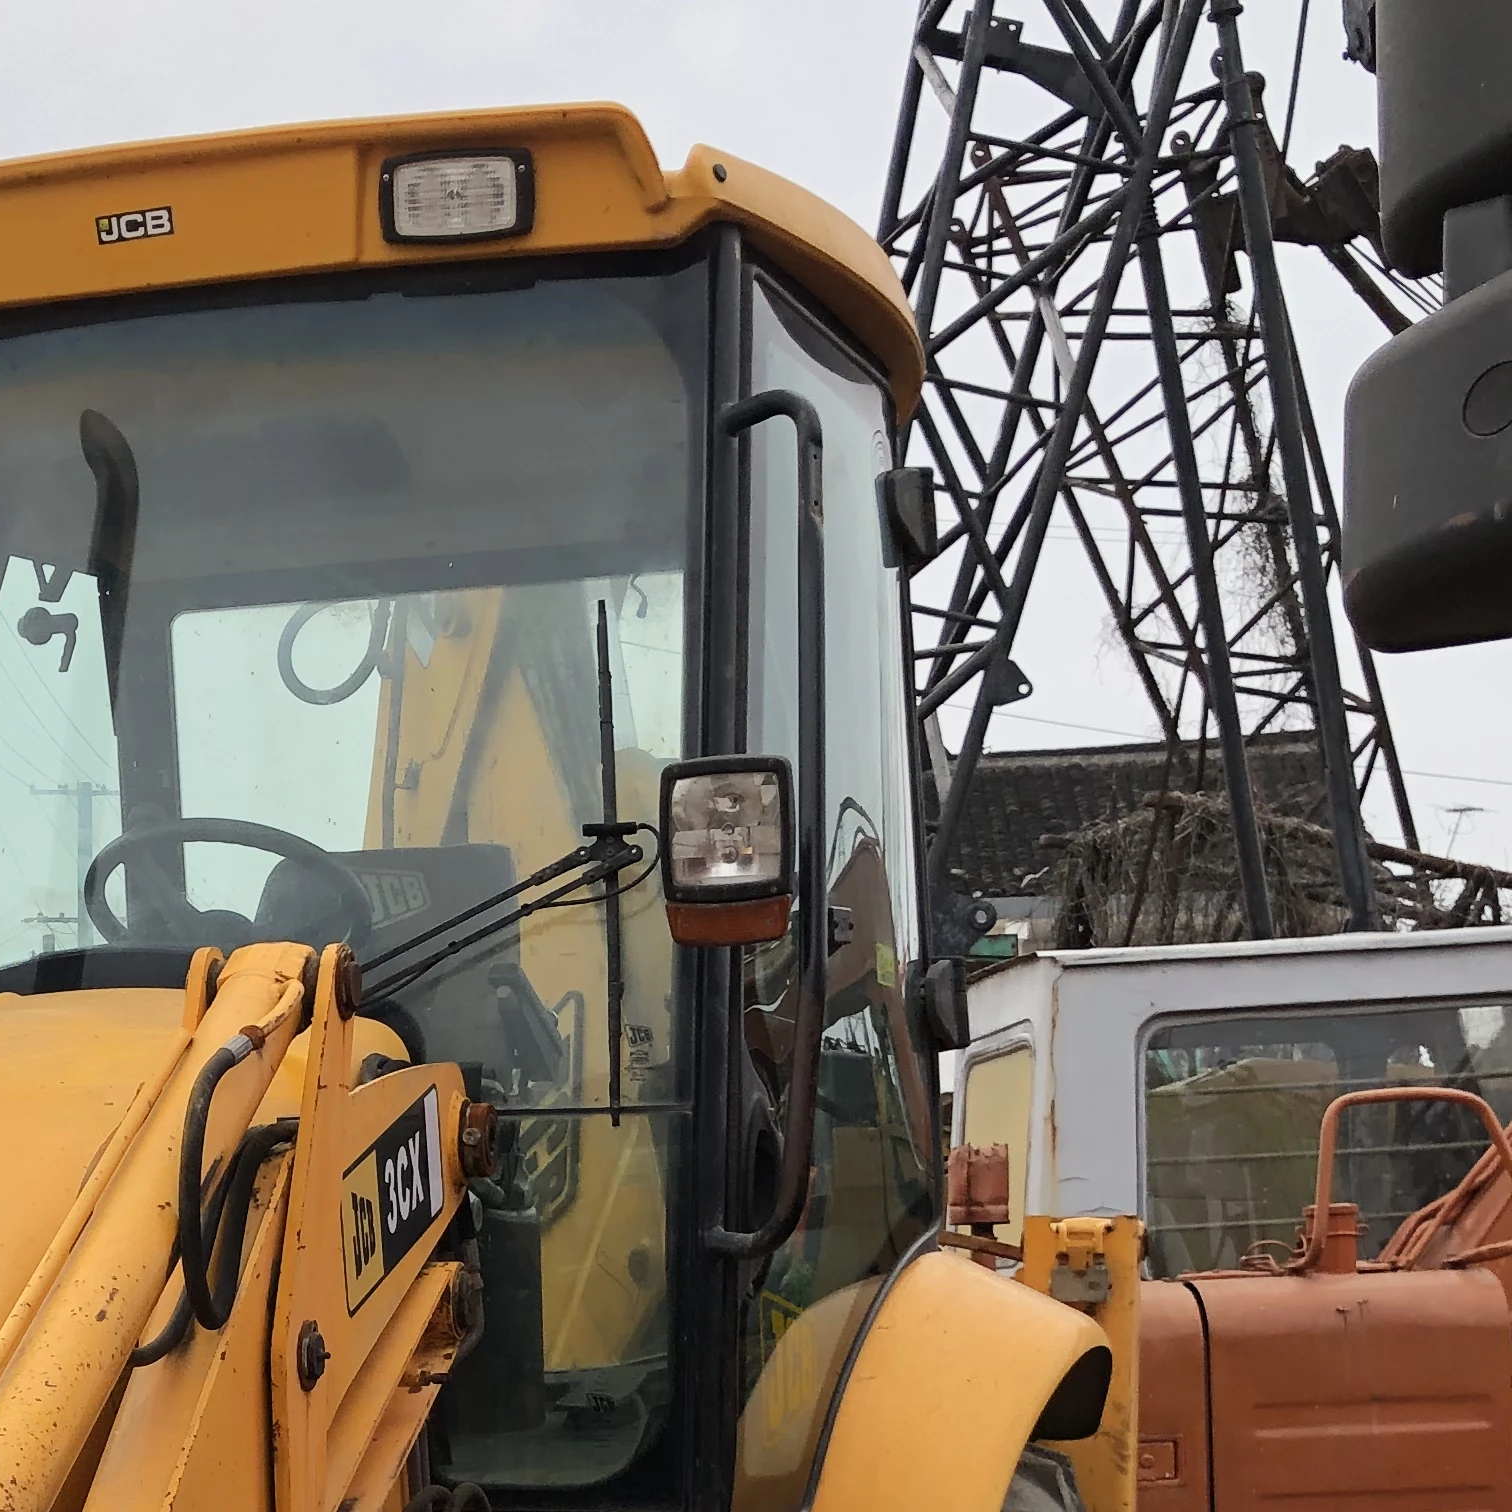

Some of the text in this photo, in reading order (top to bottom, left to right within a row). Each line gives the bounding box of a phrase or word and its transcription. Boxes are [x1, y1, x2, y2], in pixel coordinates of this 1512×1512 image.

[99, 208, 172, 242] JCB
[361, 873, 425, 925] JCB
[384, 1130, 425, 1235] 3CX
[350, 1191, 376, 1280] JCB
